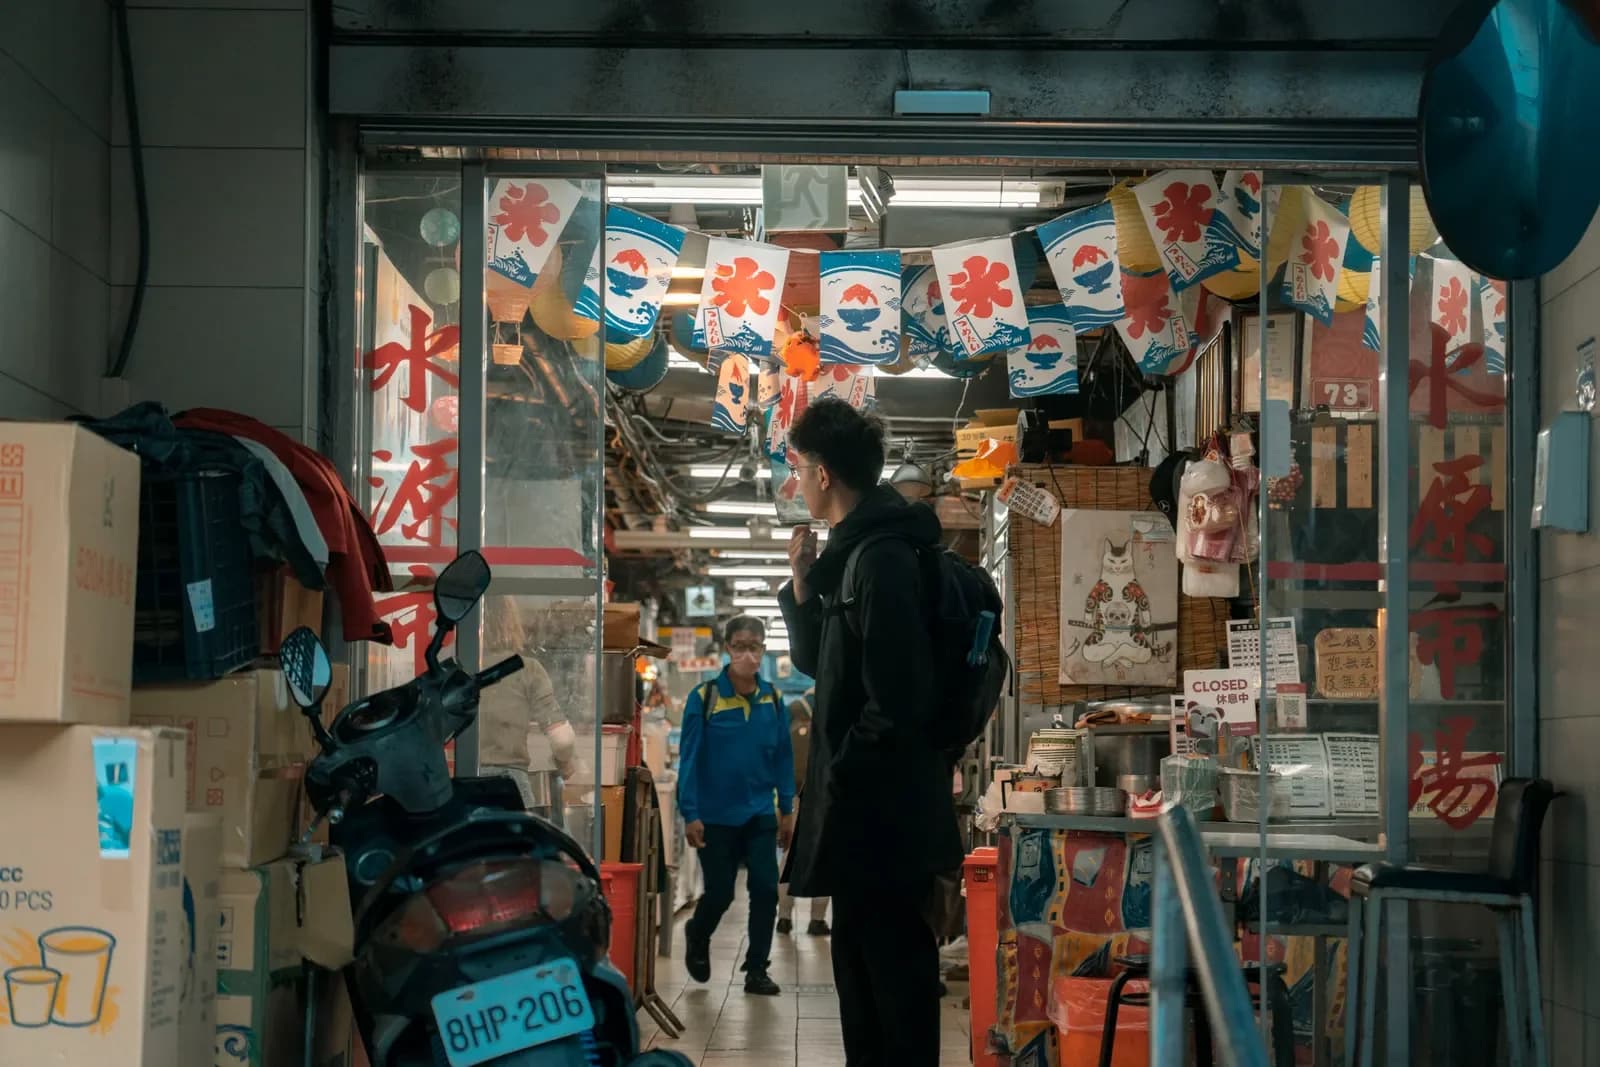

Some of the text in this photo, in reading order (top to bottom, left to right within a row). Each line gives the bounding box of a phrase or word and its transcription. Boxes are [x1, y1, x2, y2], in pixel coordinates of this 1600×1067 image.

[1169, 248, 1196, 277] つめたい
[706, 310, 720, 345] つめたい
[957, 320, 981, 352] つめたい
[1324, 384, 1358, 405] 73
[362, 304, 459, 777] 水源市
[1192, 679, 1248, 693] CLOSED
[1216, 693, 1249, 705] 休息中
[15, 890, 53, 911] PCS
